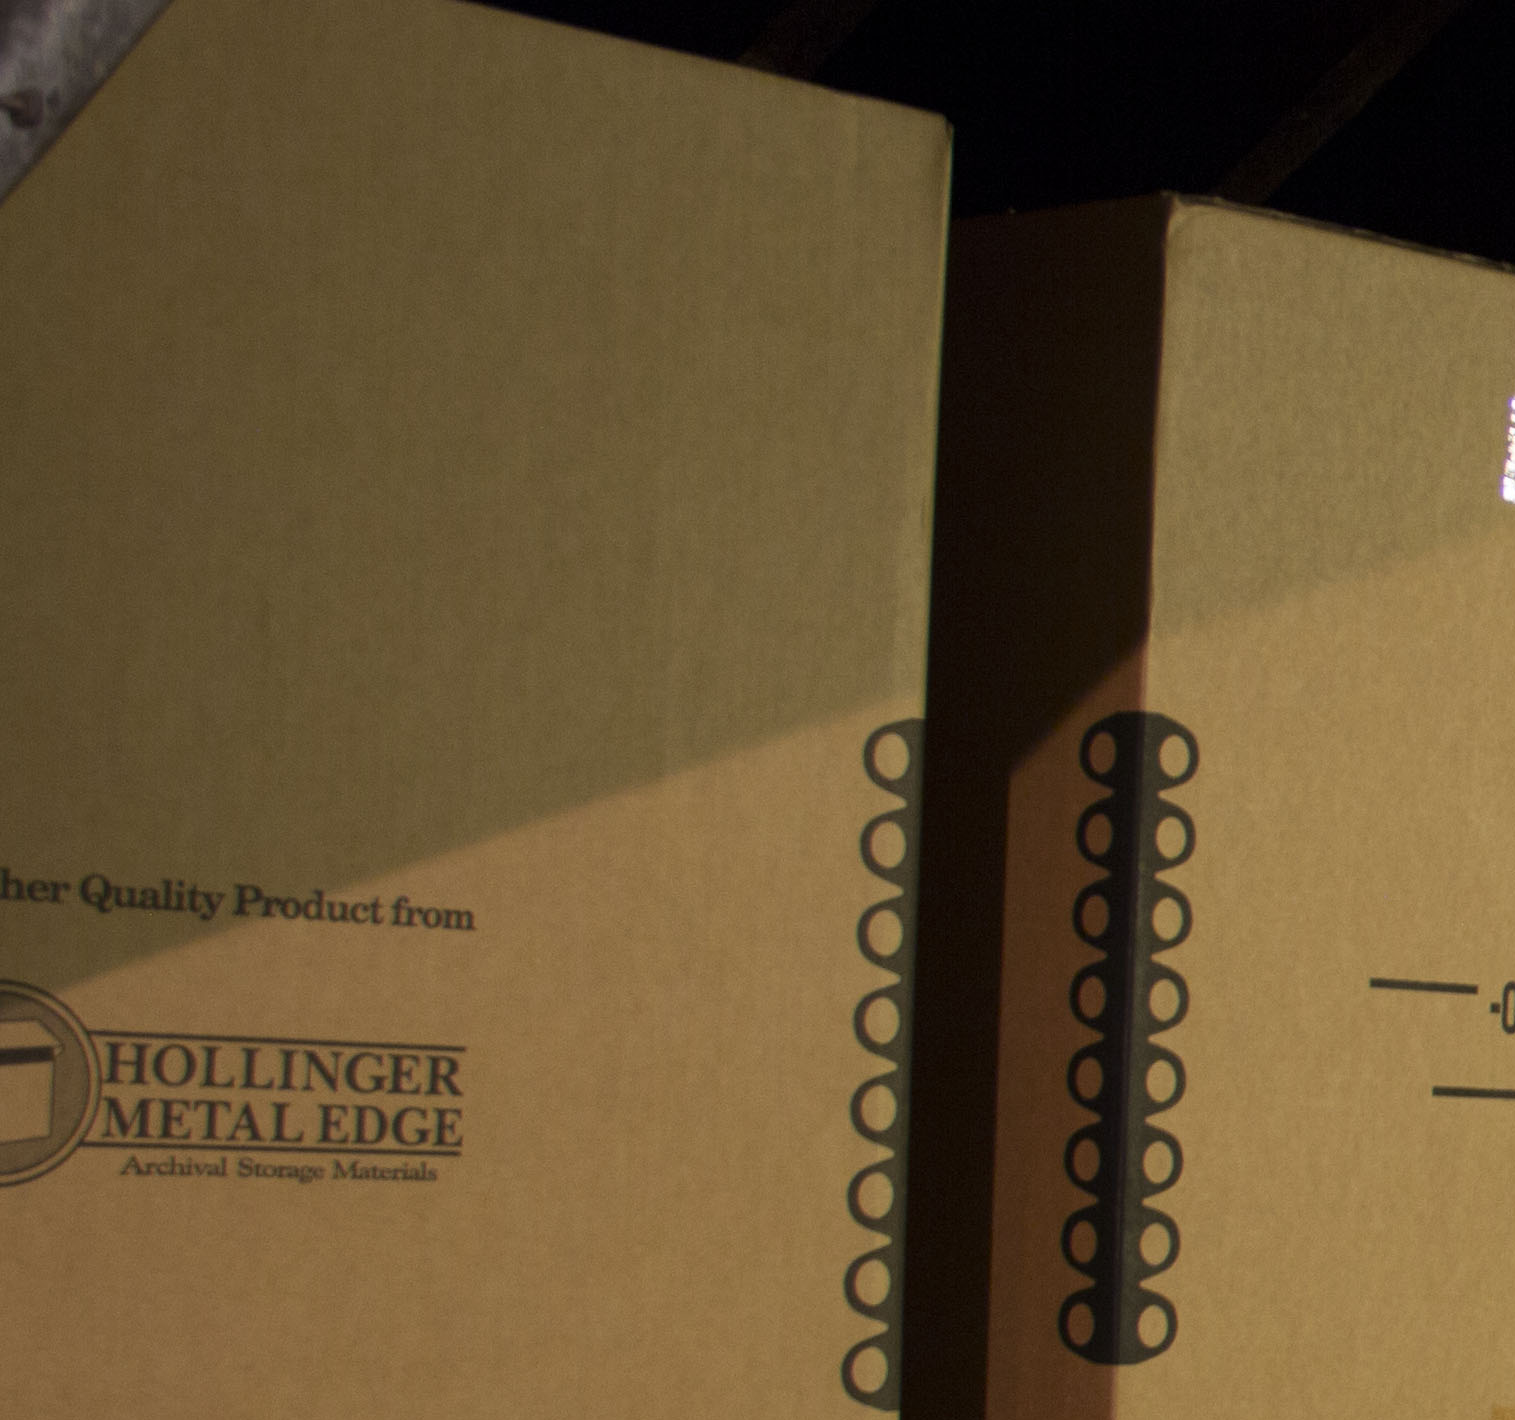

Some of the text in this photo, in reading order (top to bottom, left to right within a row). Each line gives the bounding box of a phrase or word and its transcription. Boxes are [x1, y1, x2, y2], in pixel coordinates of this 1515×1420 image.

[80, 873, 225, 920] Quality
[233, 884, 383, 926] Product
[391, 895, 476, 930] from
[105, 1041, 464, 1097] HOLLINGER
[103, 1097, 463, 1148] METAL EDGE
[120, 1155, 438, 1185] Archival Storage Materials
